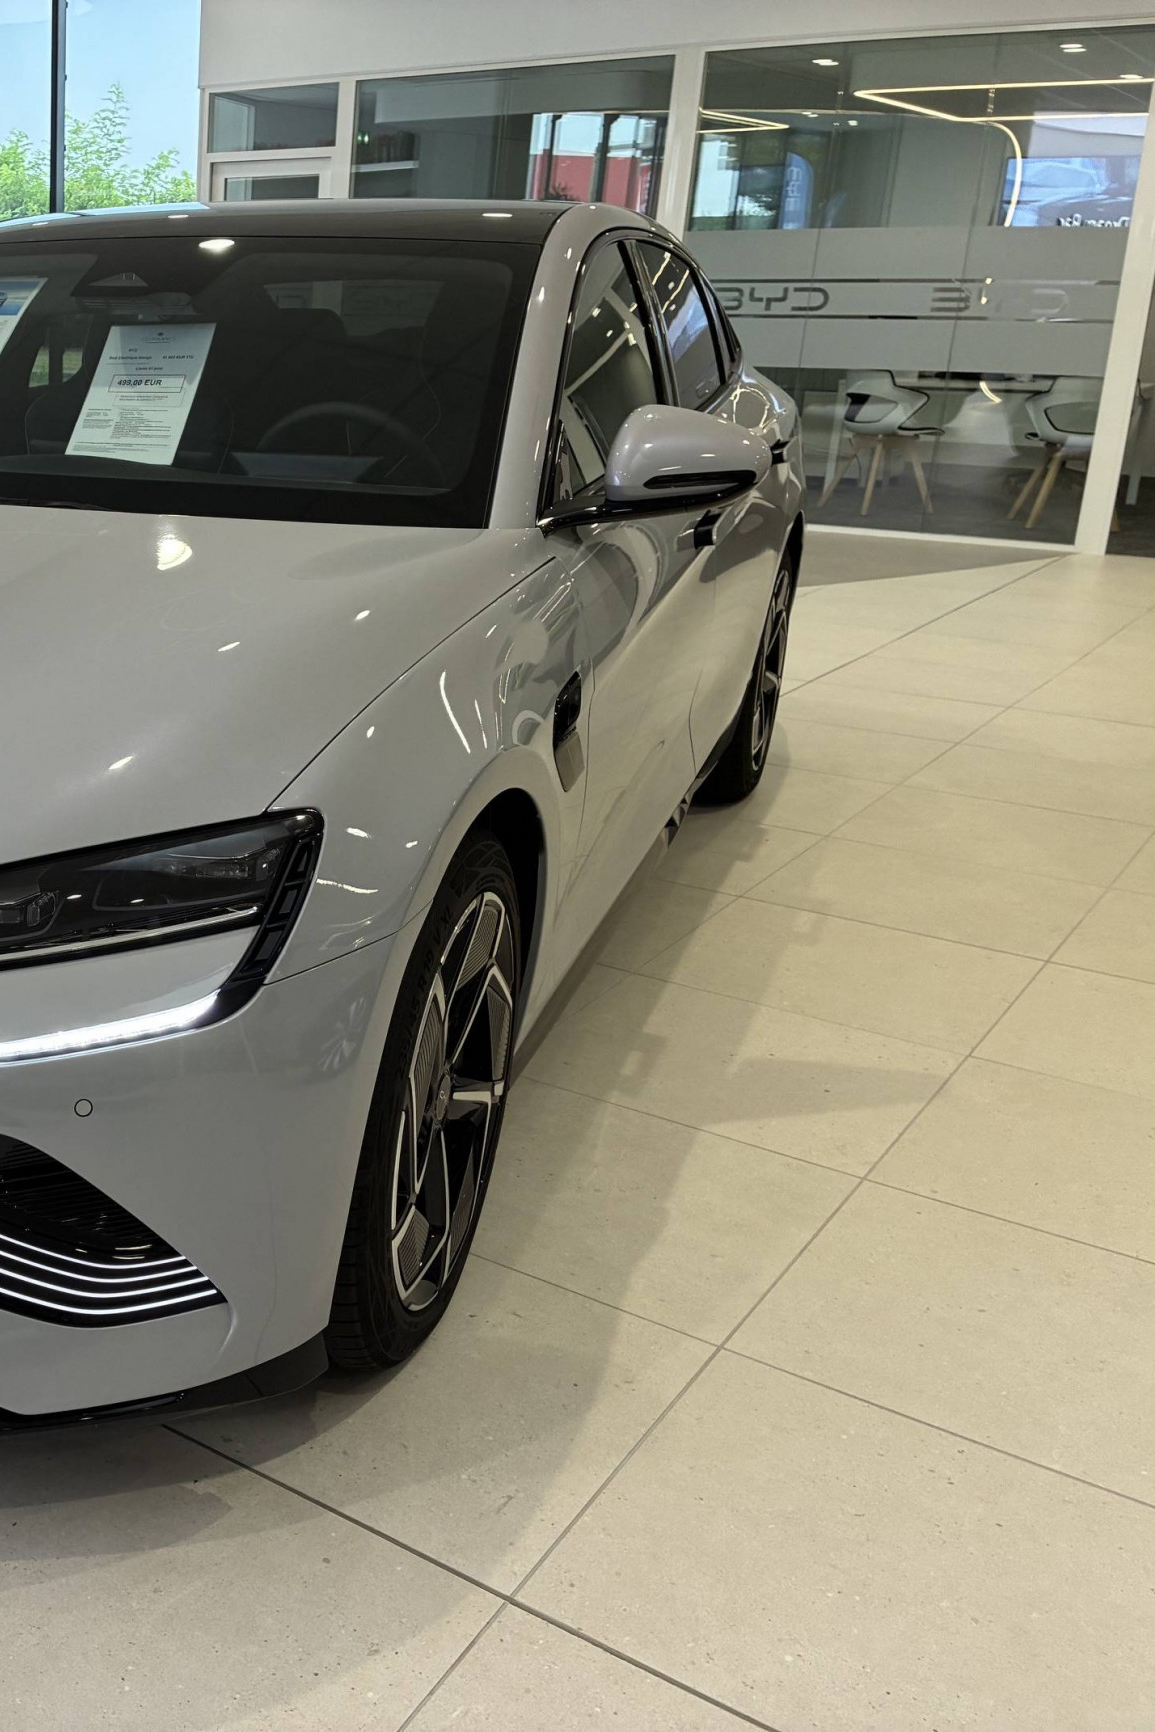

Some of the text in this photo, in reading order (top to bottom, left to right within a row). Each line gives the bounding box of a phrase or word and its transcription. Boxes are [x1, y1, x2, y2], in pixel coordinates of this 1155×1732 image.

[717, 286, 830, 313] BYD
[930, 286, 1070, 315] BD
[117, 379, 143, 387] 499,00
